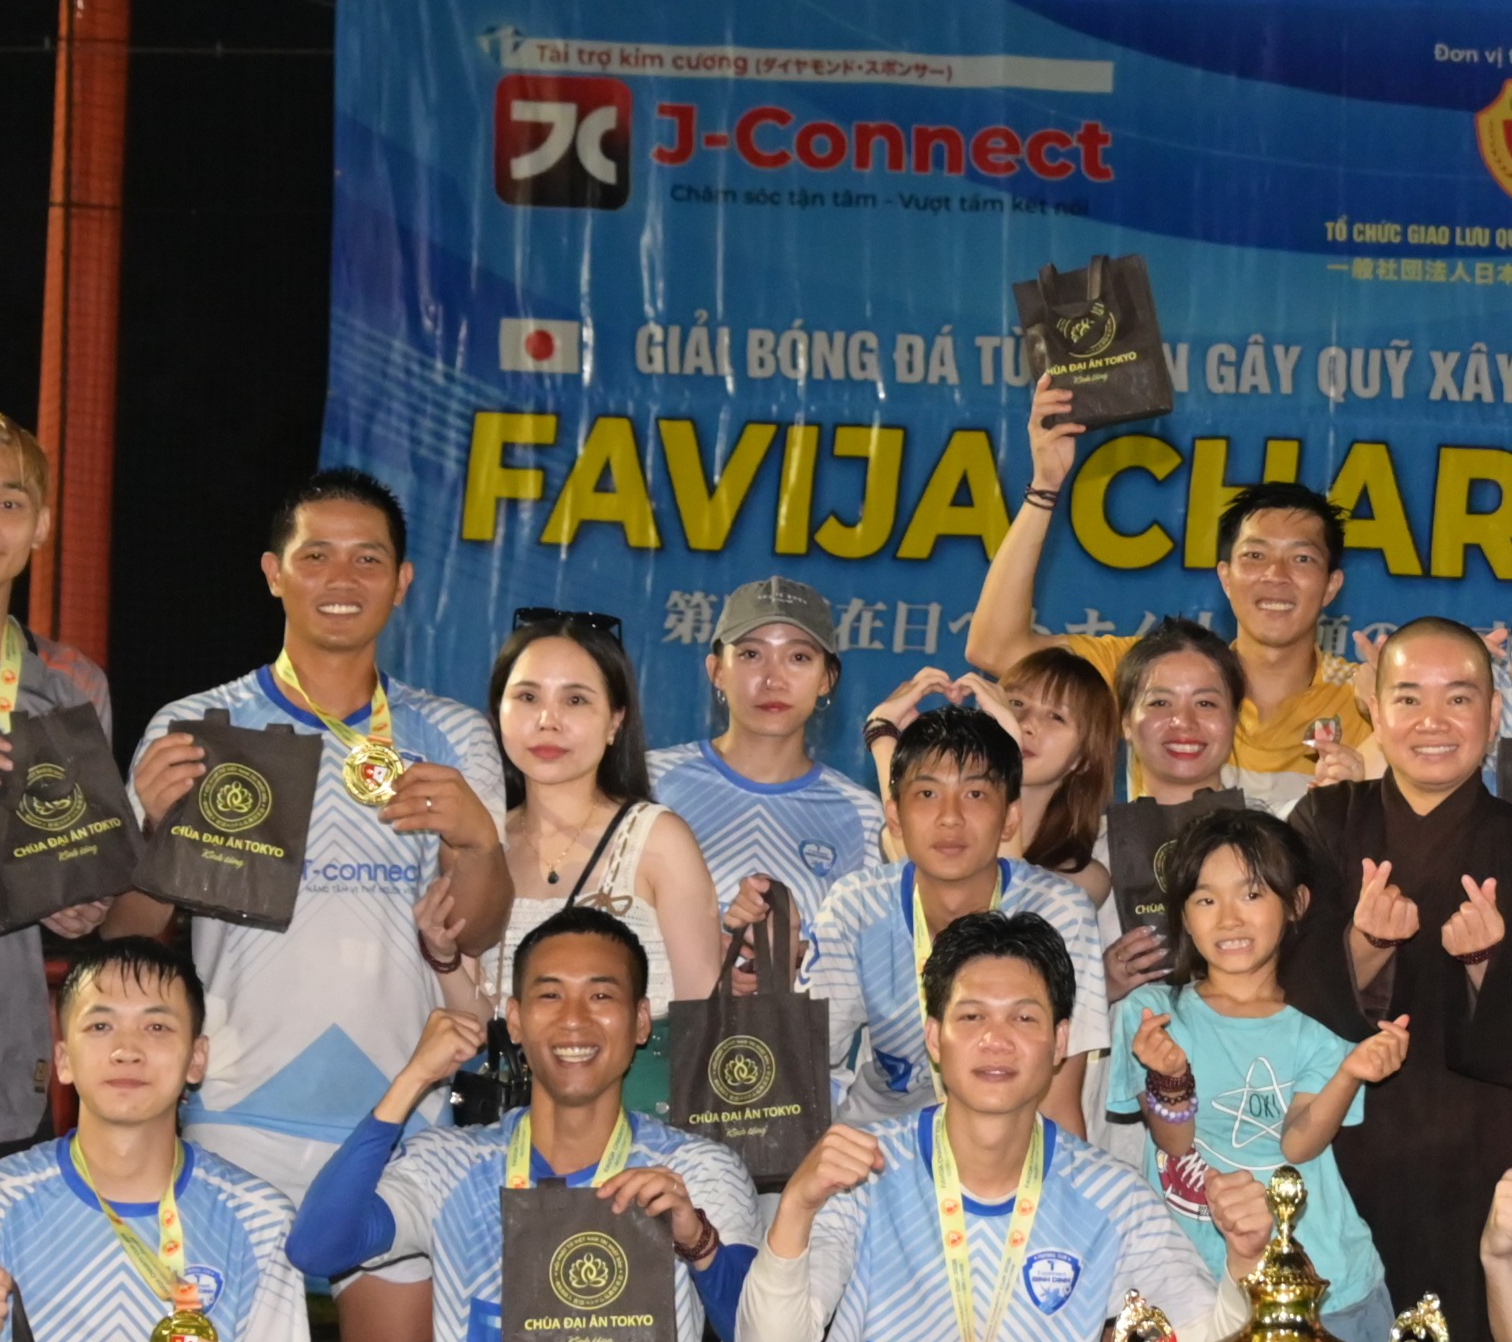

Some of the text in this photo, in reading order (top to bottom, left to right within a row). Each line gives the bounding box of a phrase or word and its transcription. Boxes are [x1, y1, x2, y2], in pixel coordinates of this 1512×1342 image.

[619, 46, 665, 69] kim
[650, 102, 1115, 182] J-Connect
[1406, 224, 1450, 245] GIAO
[635, 310, 732, 377] GIẢI
[746, 319, 881, 382] BÓNG
[893, 324, 960, 386] ĐÁ
[1205, 333, 1302, 395] GÂY
[1316, 338, 1414, 403] QUỸ
[1045, 365, 1068, 377] HÙA
[1105, 351, 1137, 366] TOKYO
[460, 409, 1008, 562] FAVIJA
[12, 841, 48, 859] CHÙA
[88, 817, 123, 836] TOKYO
[243, 840, 285, 859] TOKYO
[688, 1110, 720, 1125] CHÙA
[763, 1103, 802, 1118] TOKYO
[524, 1316, 560, 1331] CHÙA
[589, 1313, 609, 1328] ÂN
[611, 1314, 654, 1328] TOKYO
